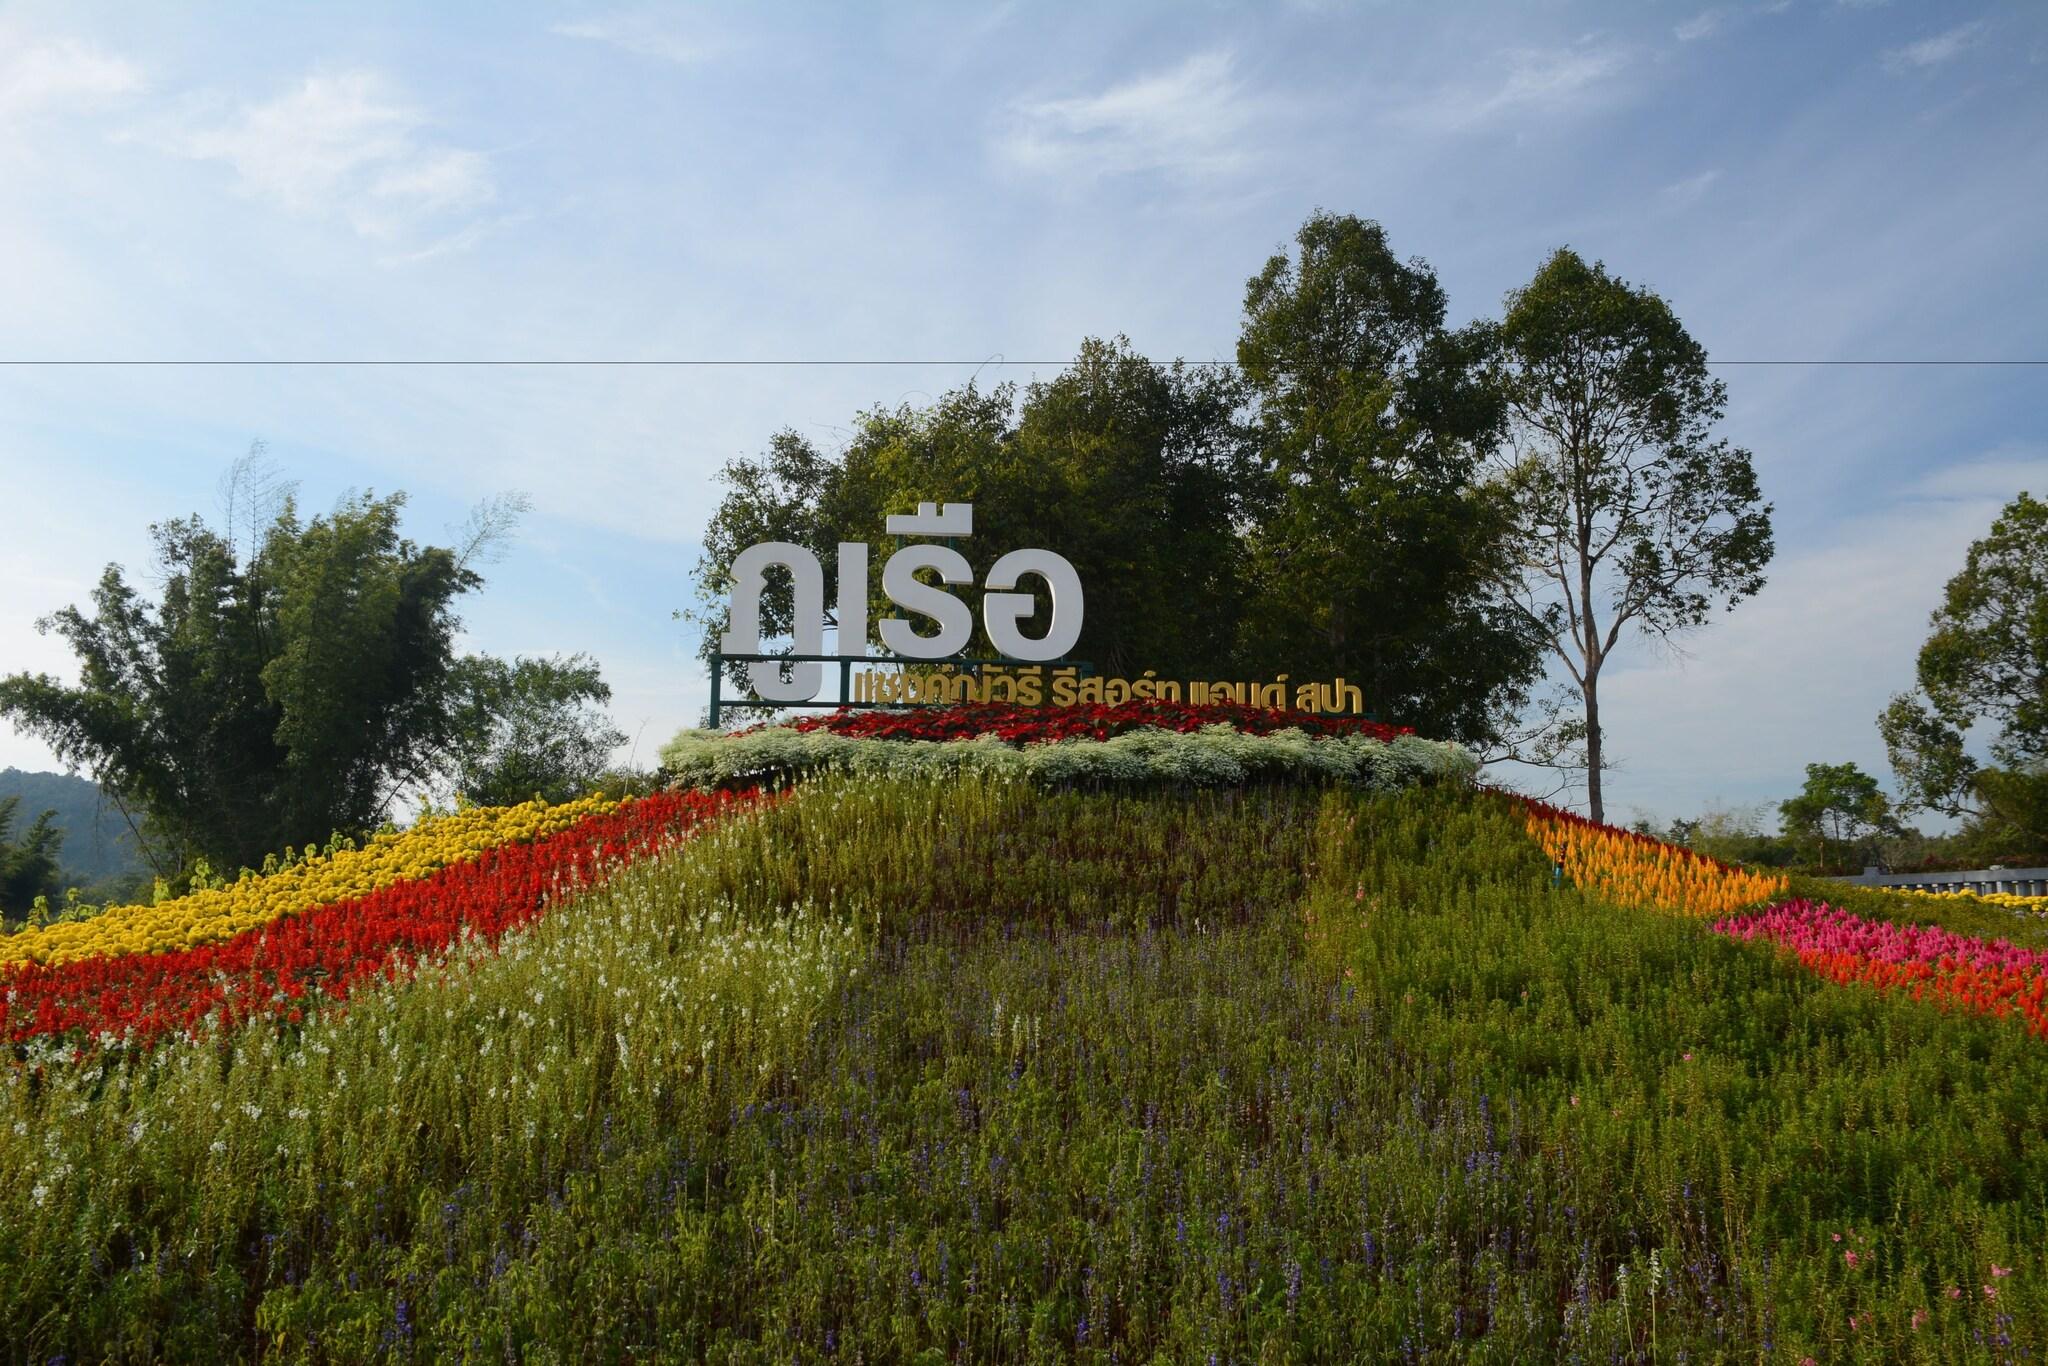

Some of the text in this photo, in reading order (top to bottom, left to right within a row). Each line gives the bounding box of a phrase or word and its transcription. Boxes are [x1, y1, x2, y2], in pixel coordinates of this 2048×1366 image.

[720, 502, 1084, 701] ภูเรือ
[1052, 666, 1181, 708] รีสอร์ท
[1189, 674, 1289, 713] แอนด์
[1296, 677, 1363, 714] สปา
